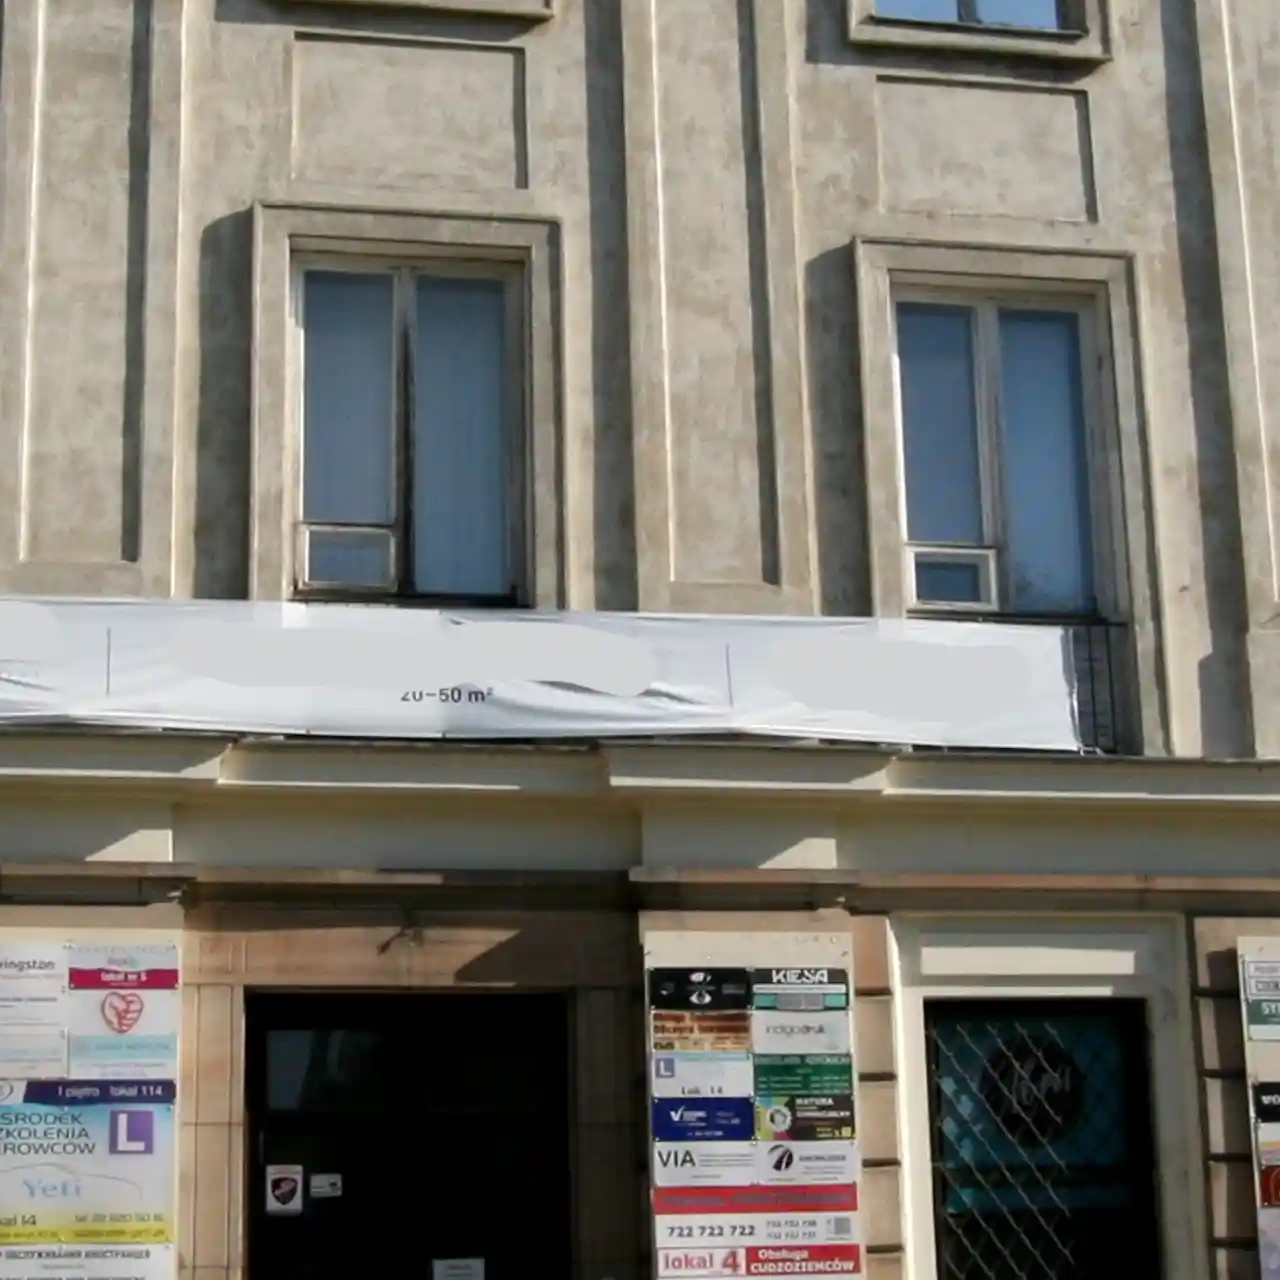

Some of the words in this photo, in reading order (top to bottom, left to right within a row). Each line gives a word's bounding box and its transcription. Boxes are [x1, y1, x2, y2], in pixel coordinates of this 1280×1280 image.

[660, 1060, 673, 1075] L
[110, 1085, 138, 1096] lokal
[141, 1085, 163, 1095] 114
[117, 1113, 146, 1151] L
[657, 1150, 696, 1168] VIA
[667, 1226, 694, 1237] 722
[698, 1226, 725, 1236] 722
[729, 1225, 756, 1236] 722
[664, 1253, 714, 1269] lokal
[722, 1250, 740, 1272] 4
